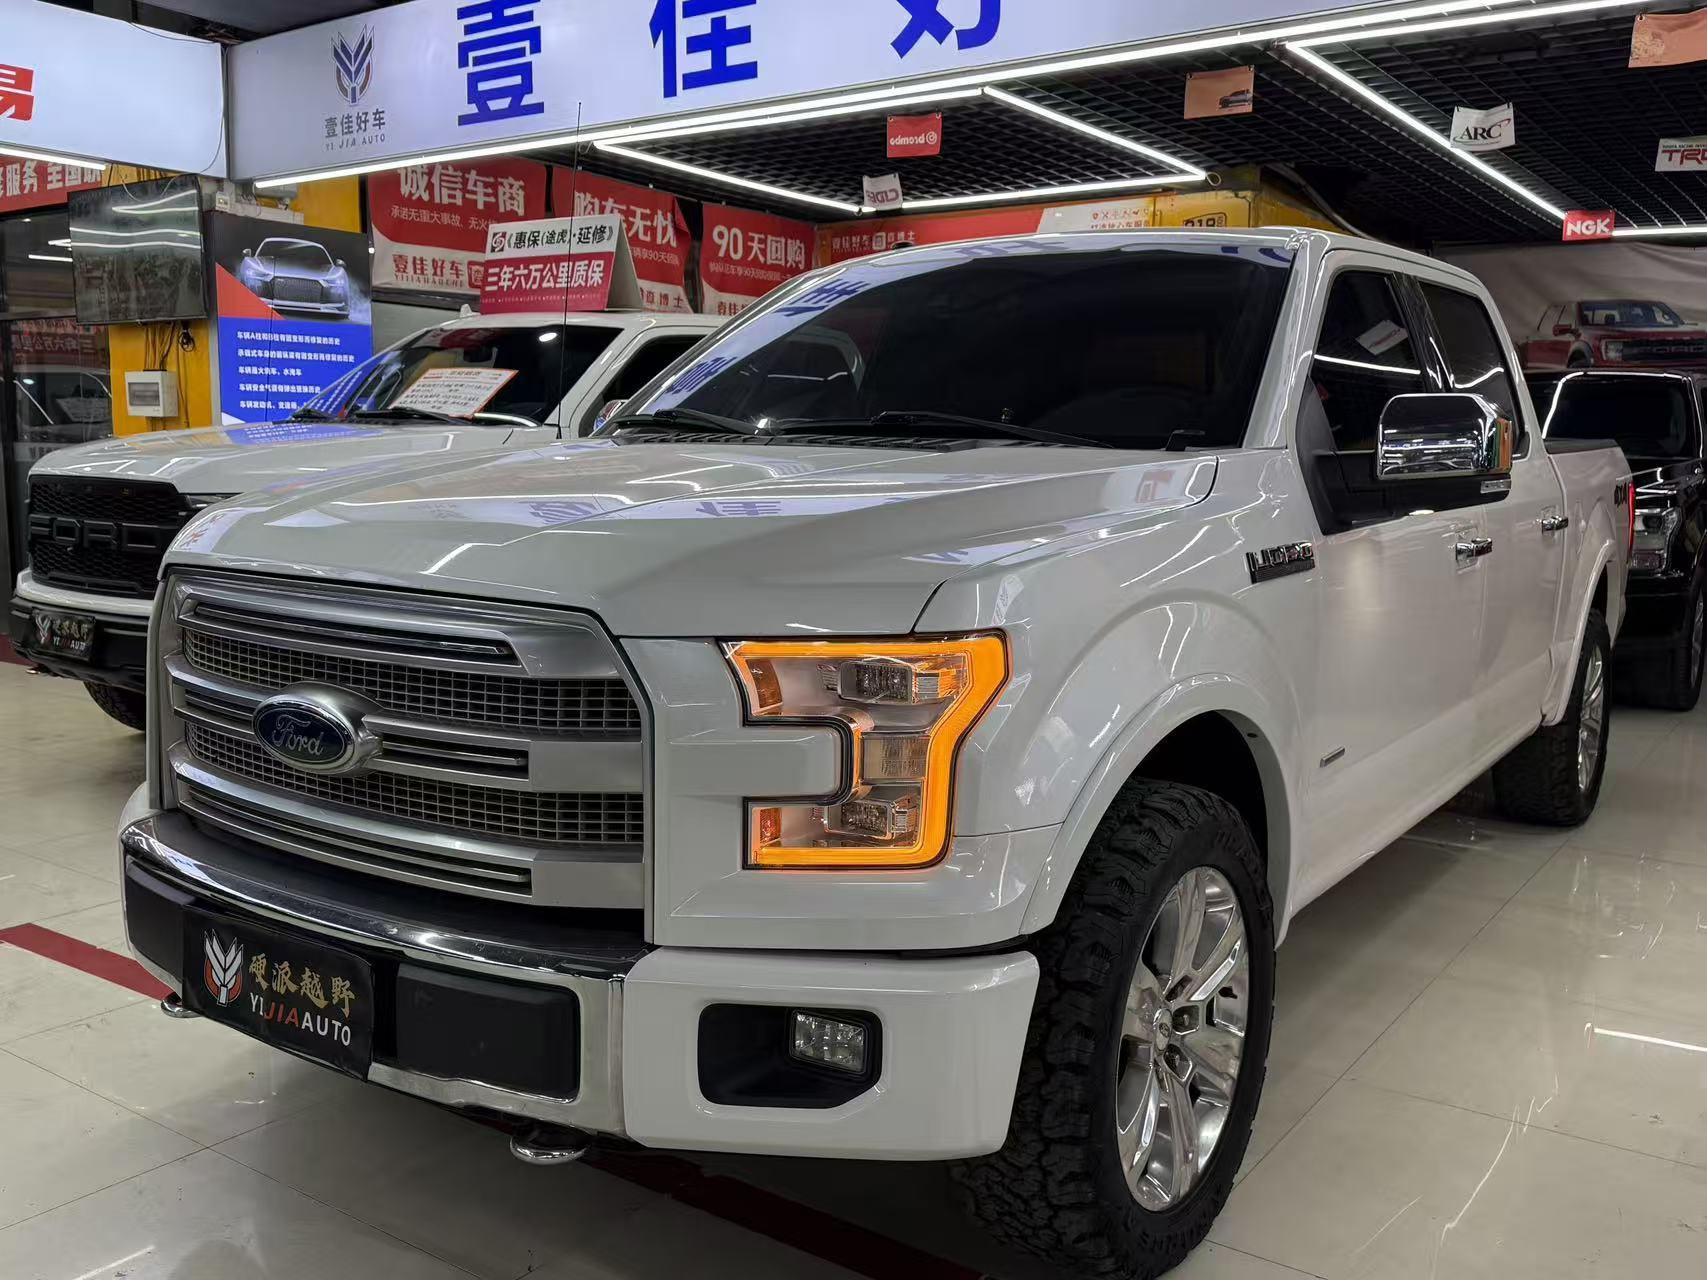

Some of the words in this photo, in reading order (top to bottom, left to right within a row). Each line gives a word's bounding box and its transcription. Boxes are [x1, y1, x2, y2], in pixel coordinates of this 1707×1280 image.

[325, 108, 385, 138] 壹佳好车
[1460, 124, 1501, 140] ARC
[339, 138, 356, 149] JIA
[362, 134, 385, 145] AUTO
[0, 160, 39, 197] 服务
[397, 165, 525, 216] 诚信车商
[1567, 217, 1610, 236] NGK
[713, 225, 805, 269] 90天回购
[392, 254, 465, 279] 壹佳好车
[485, 260, 604, 292] 三年六万公里质保
[272, 714, 324, 756] Ford
[248, 953, 356, 1019] 硬派越野
